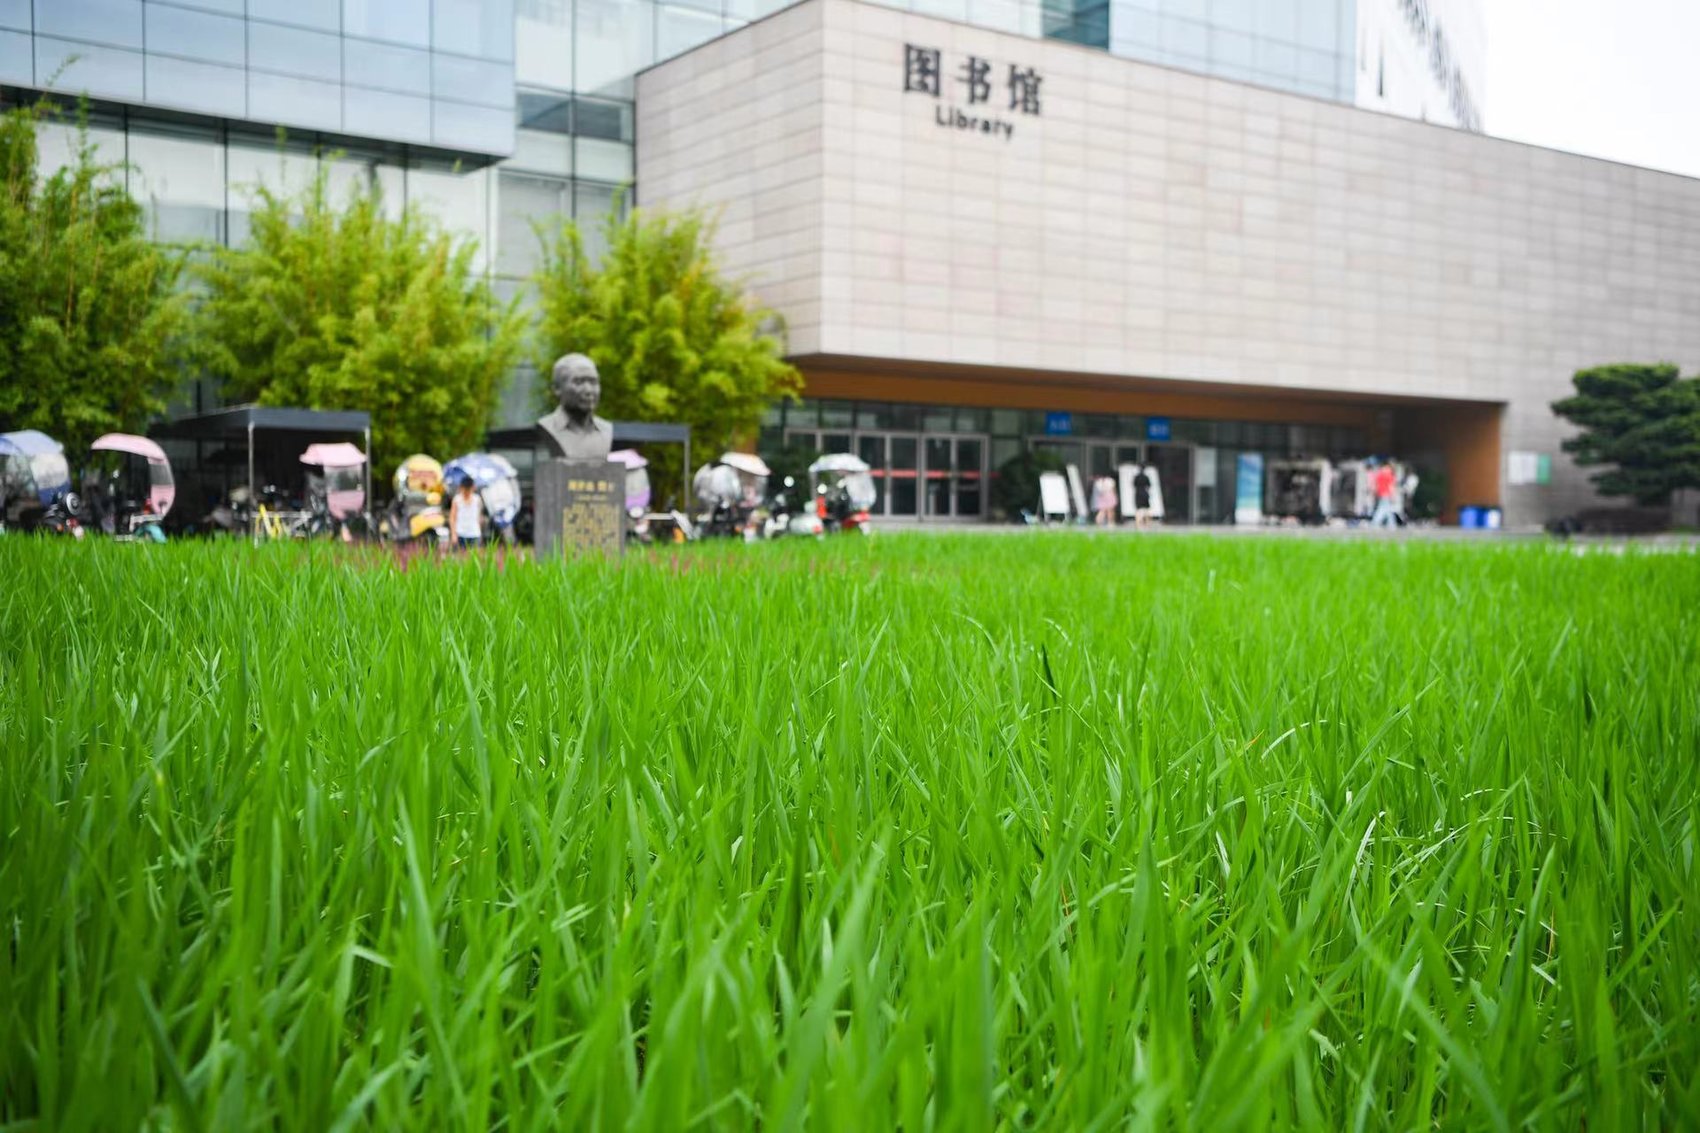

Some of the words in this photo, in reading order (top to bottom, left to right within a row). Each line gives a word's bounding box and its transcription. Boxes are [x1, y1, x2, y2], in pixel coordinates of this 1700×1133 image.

[904, 43, 1042, 115] 图书馆
[936, 105, 1013, 139] Library
